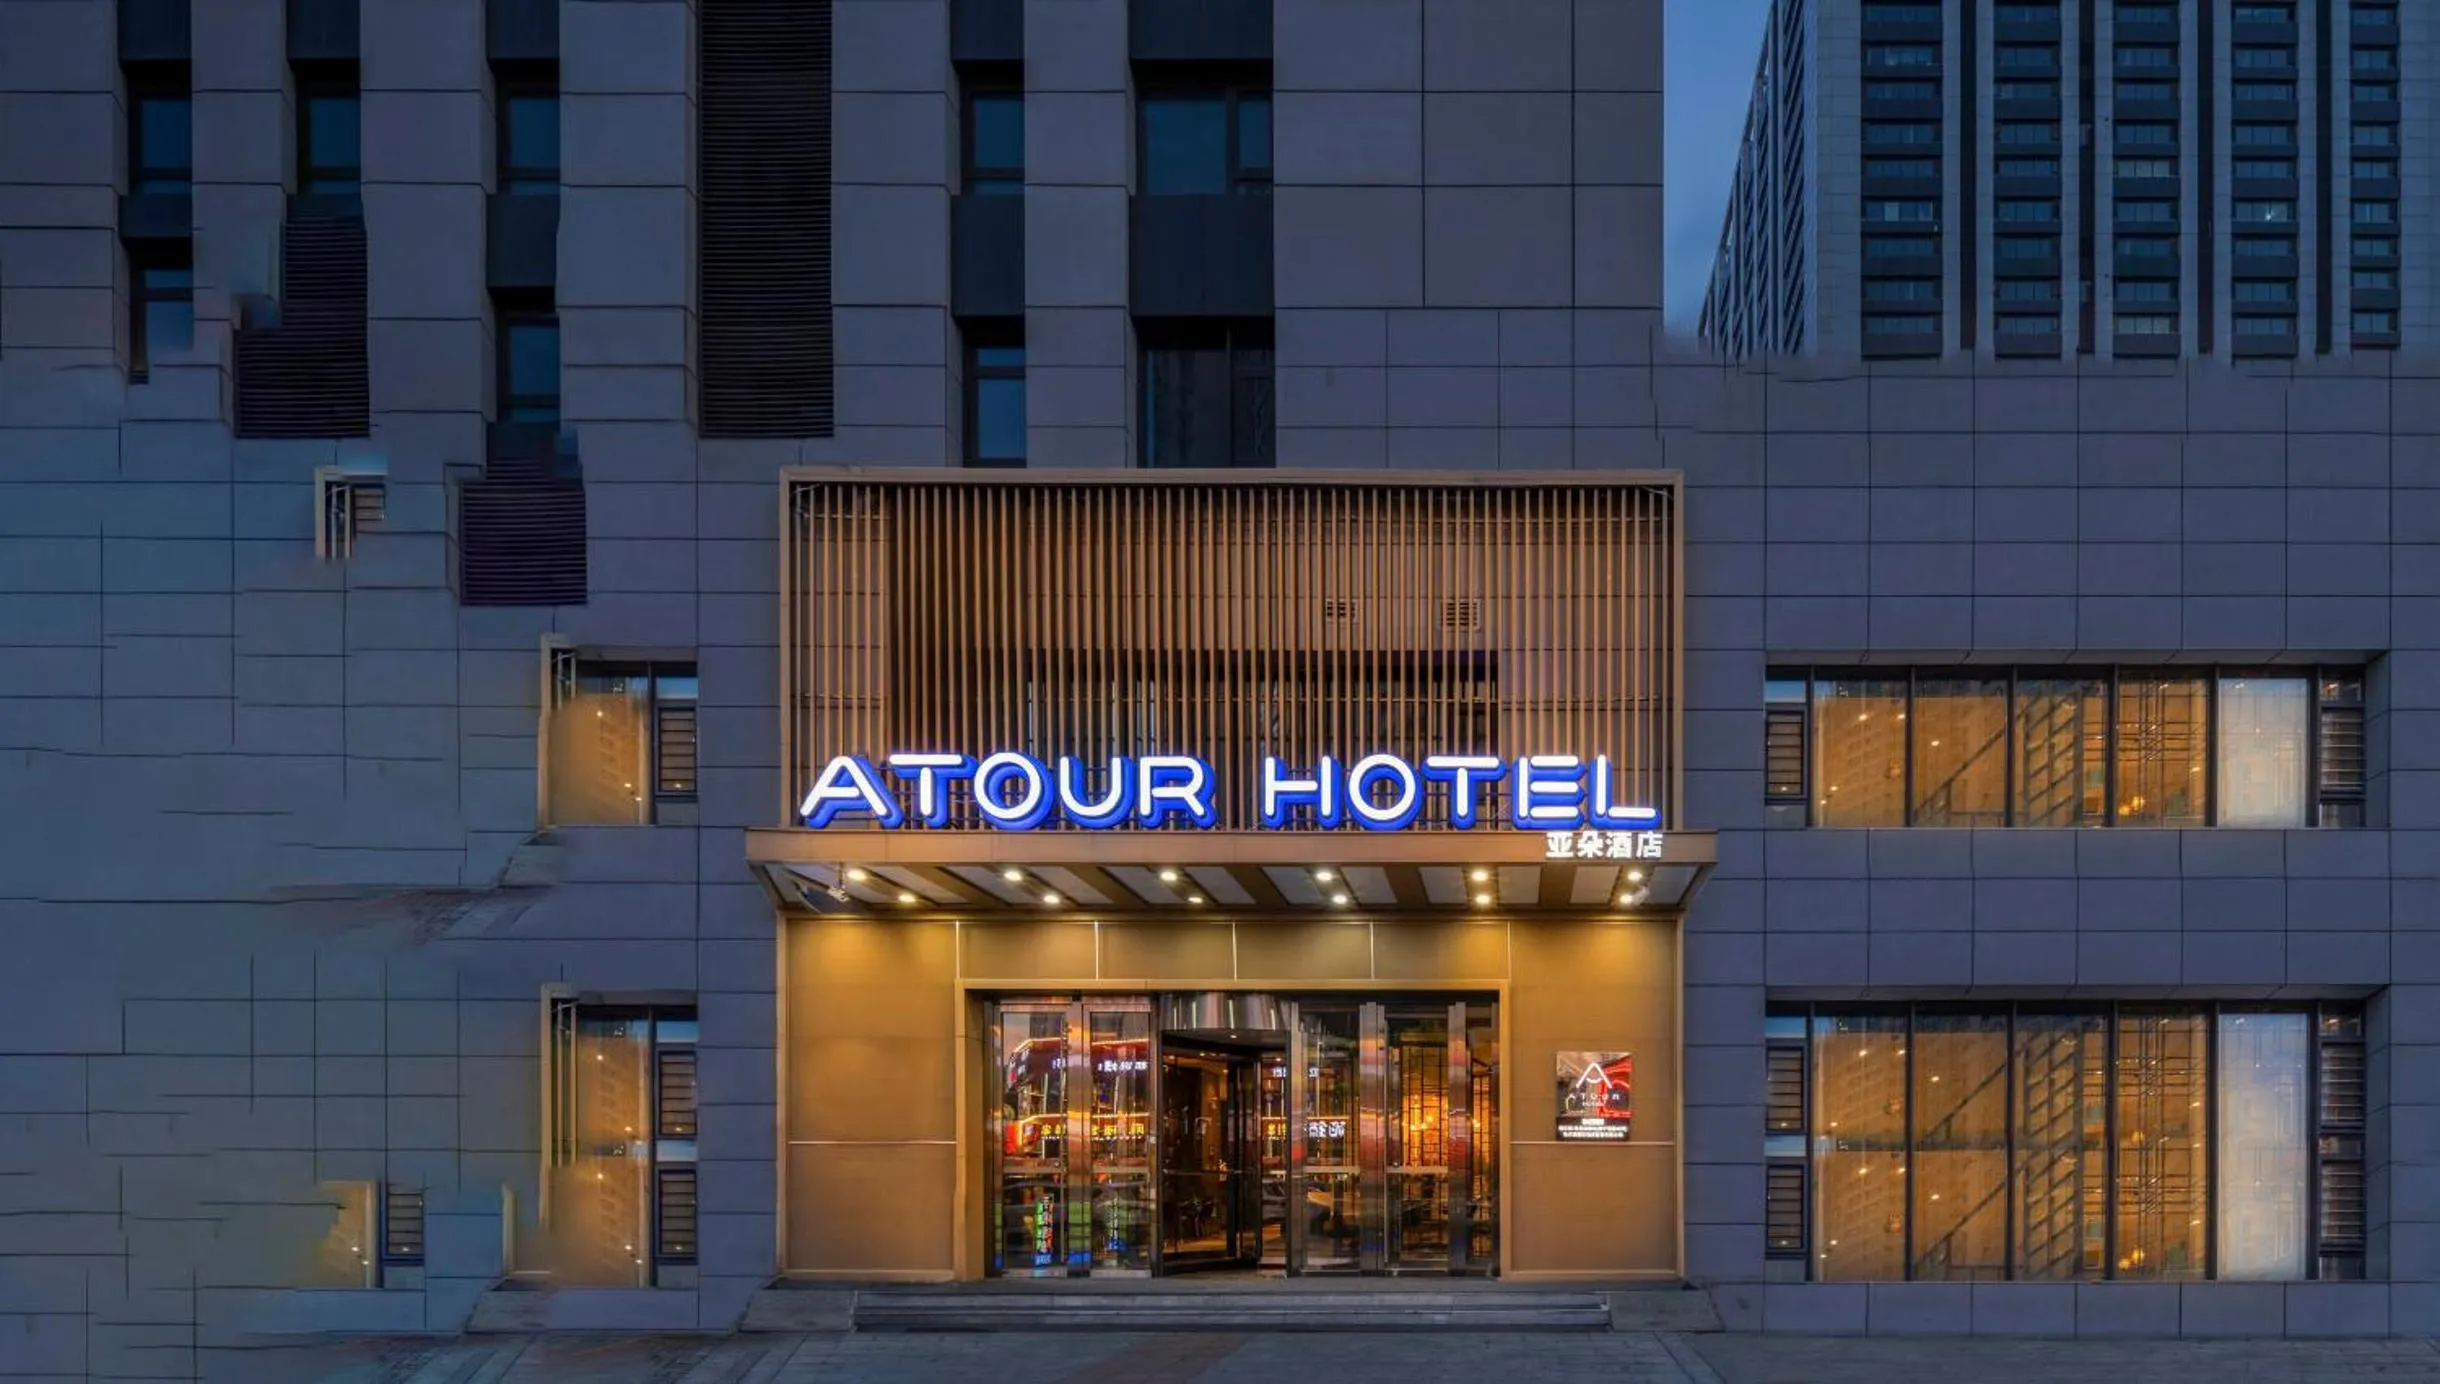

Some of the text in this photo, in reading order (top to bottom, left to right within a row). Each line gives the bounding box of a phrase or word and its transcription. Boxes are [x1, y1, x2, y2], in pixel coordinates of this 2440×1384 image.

[800, 752, 1661, 832] ATOUR HOTEL
[1546, 830, 1663, 859] 亚朵酒店
